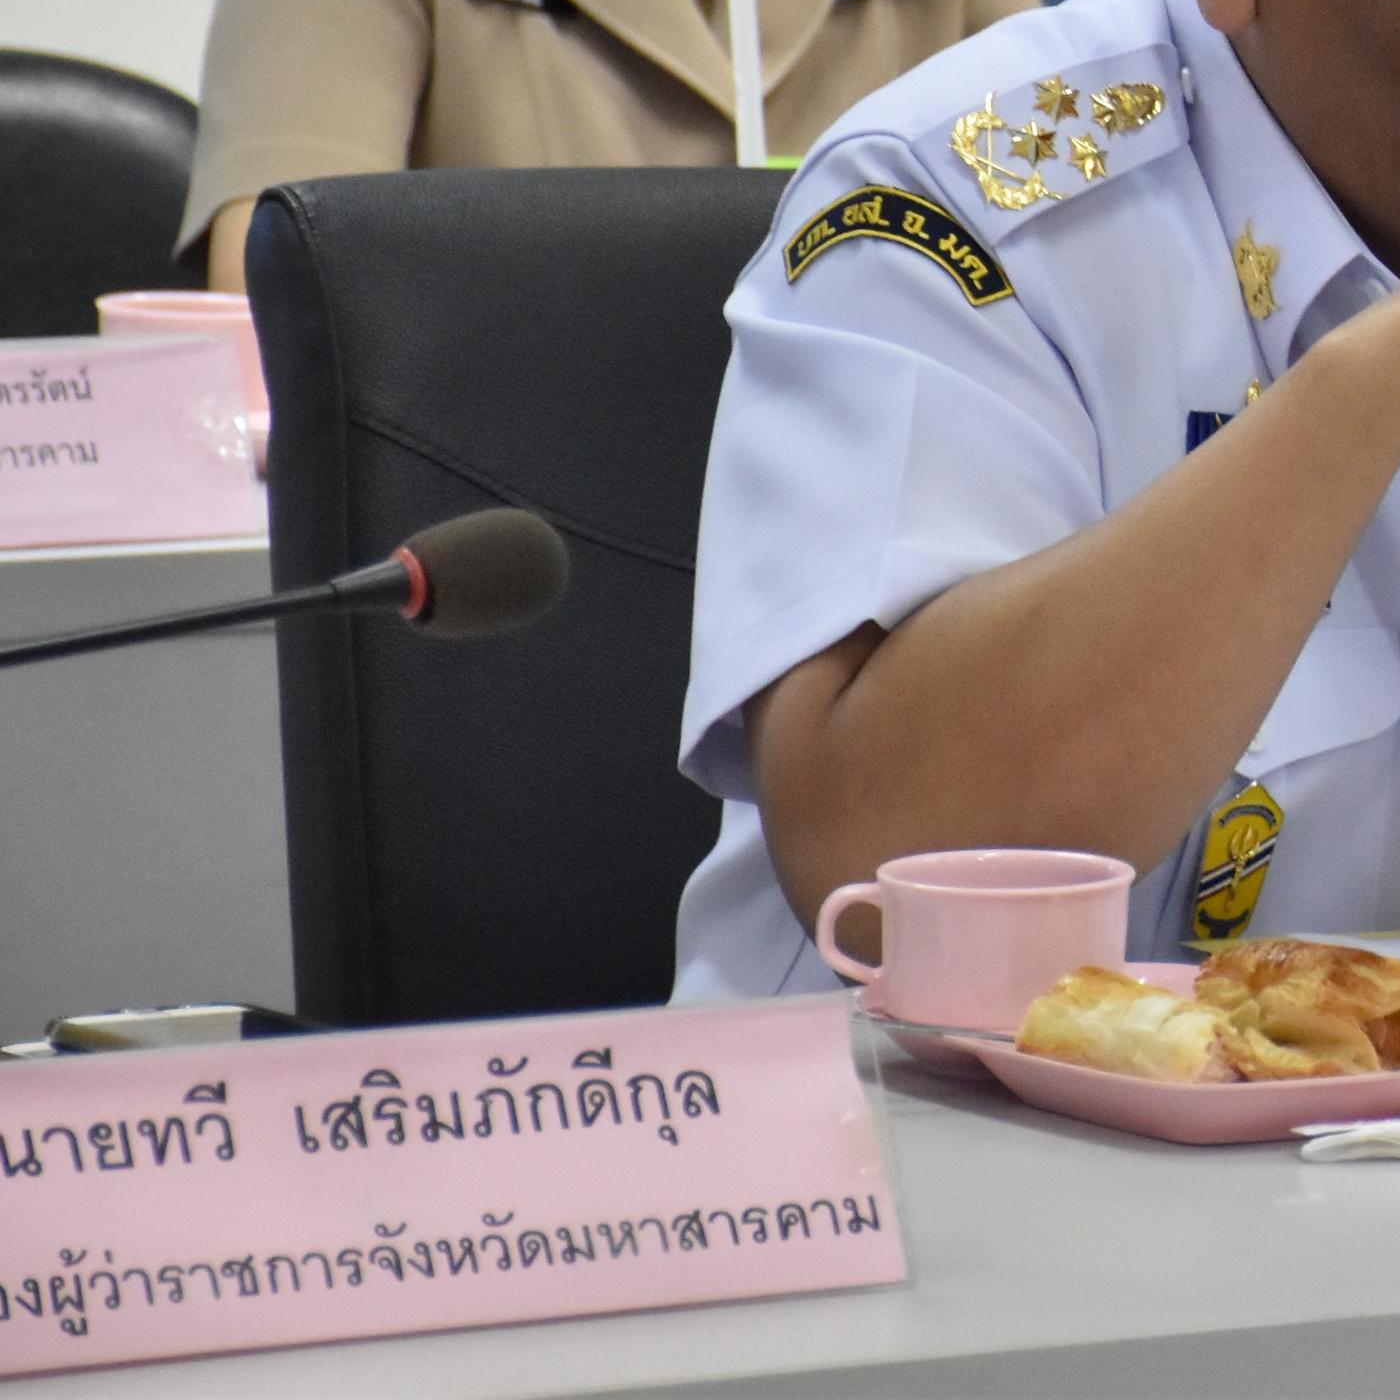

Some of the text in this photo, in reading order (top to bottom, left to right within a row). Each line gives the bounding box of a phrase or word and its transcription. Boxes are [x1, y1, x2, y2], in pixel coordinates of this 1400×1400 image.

[0, 1046, 721, 1178] นายทวี เสริมภักดีกุล
